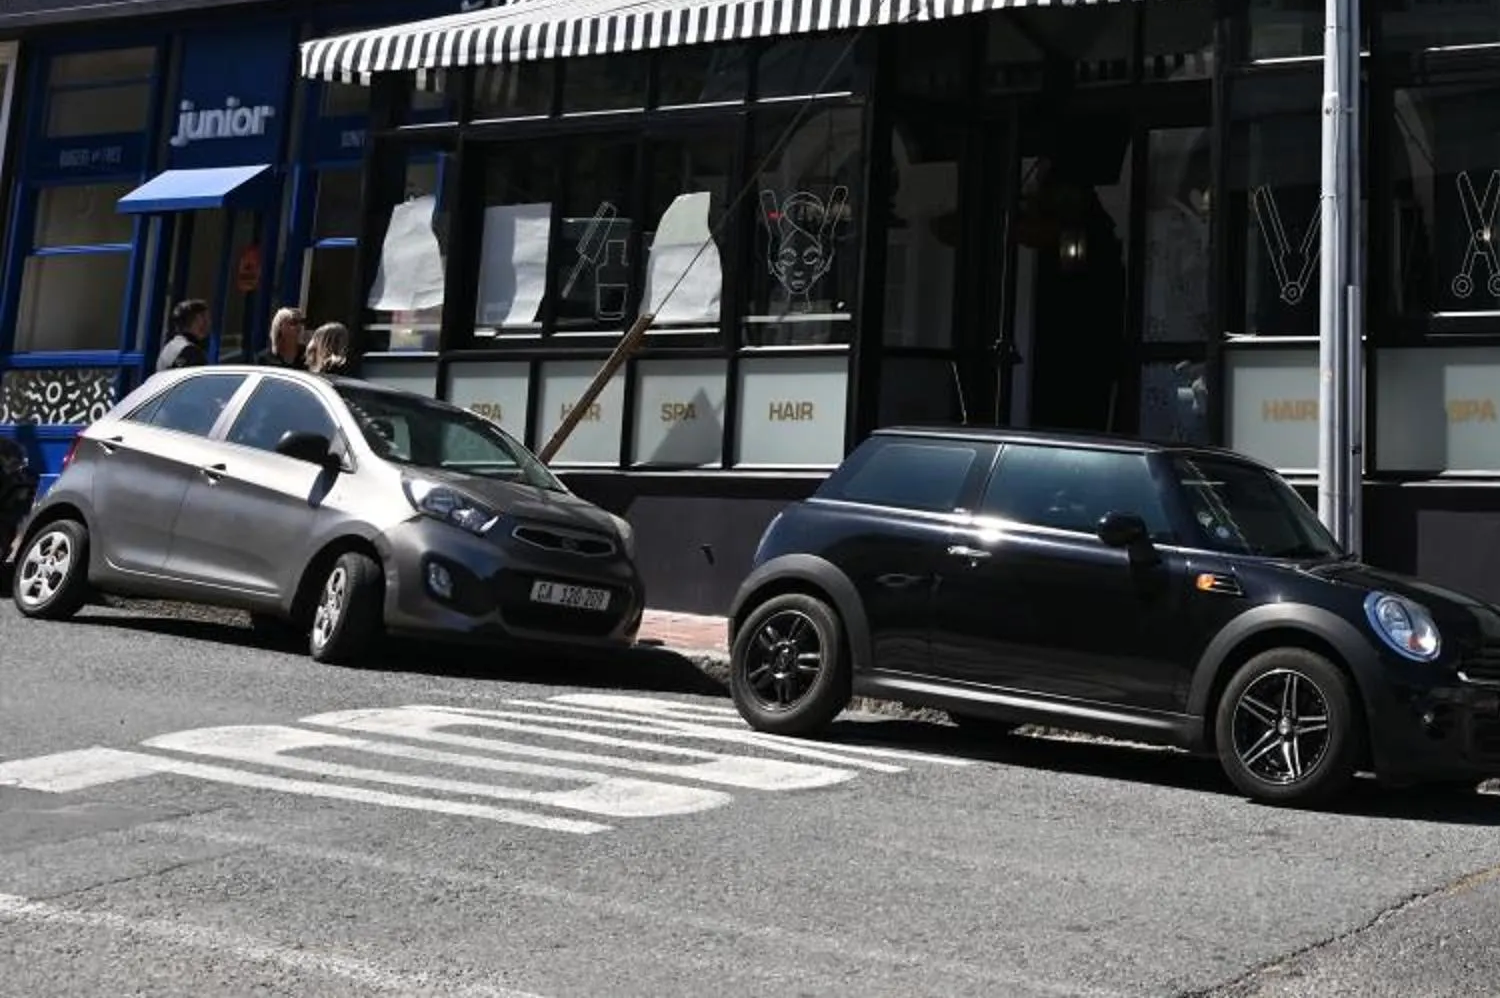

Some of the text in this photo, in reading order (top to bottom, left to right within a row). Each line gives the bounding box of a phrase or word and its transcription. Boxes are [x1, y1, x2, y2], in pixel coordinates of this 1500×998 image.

[170, 96, 275, 147] junior
[561, 403, 602, 421] HR
[661, 403, 696, 422] SPA
[769, 401, 814, 421] HAIR
[1262, 399, 1319, 422] HAIR
[1448, 399, 1497, 422] SPA
